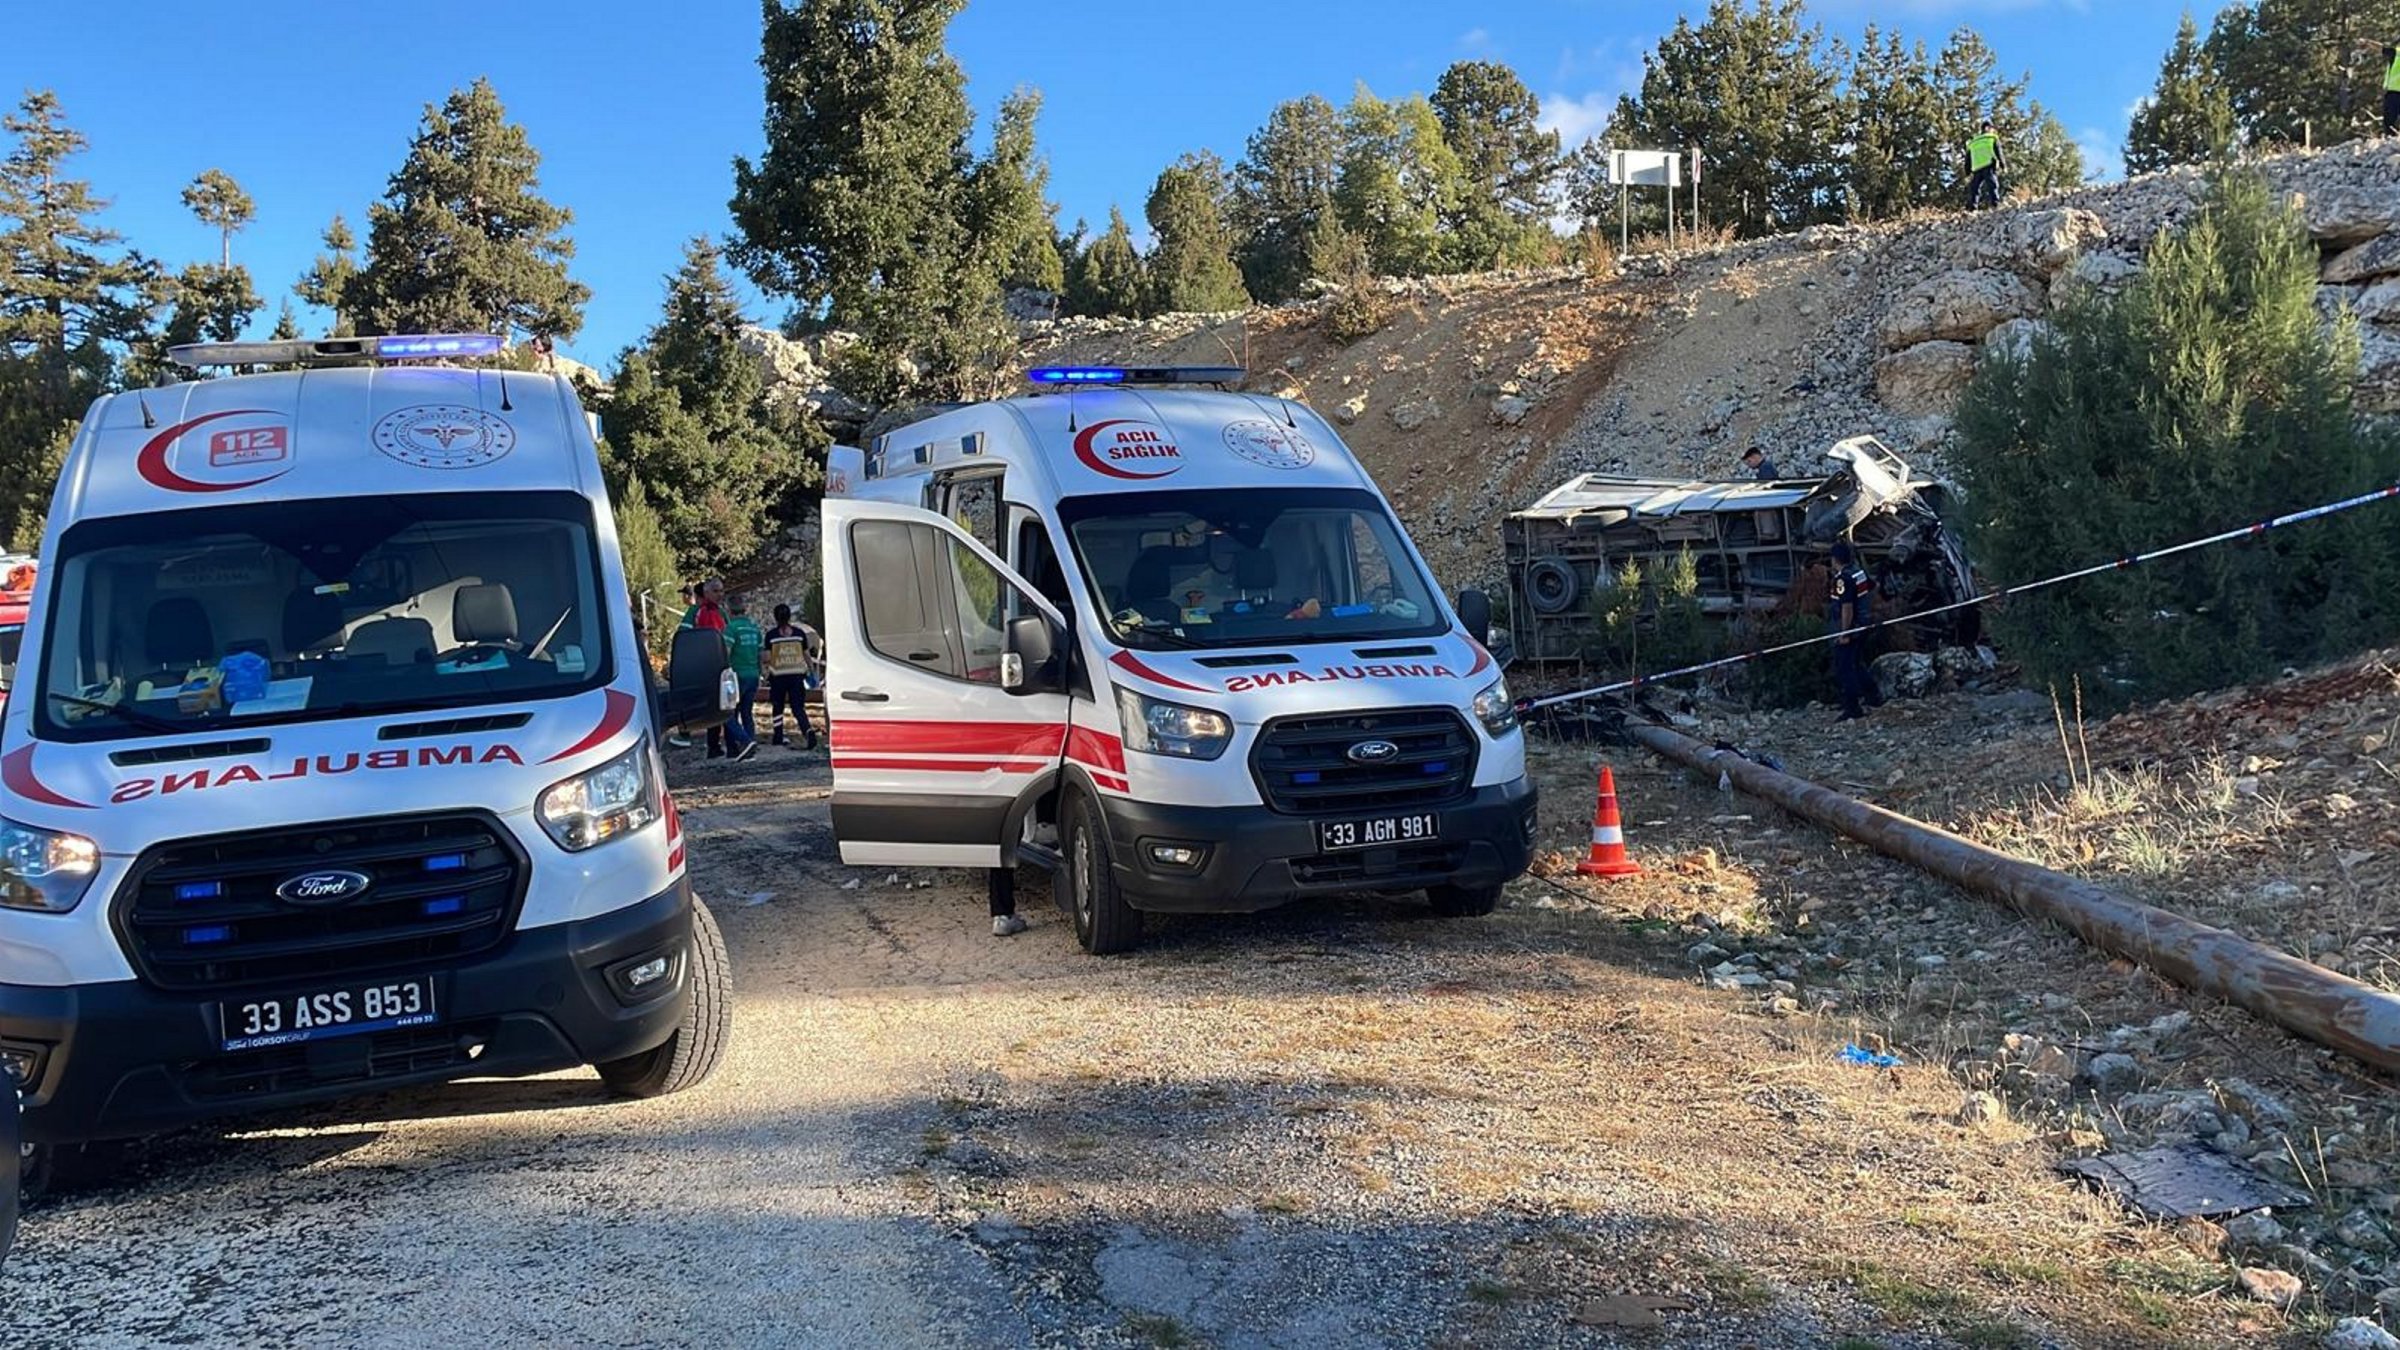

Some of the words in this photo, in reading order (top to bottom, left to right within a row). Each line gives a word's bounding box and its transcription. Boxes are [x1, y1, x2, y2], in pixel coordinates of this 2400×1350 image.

[222, 431, 274, 451] 112
[1108, 444, 1181, 459] SAĞLIK
[1333, 824, 1355, 844] 33
[1365, 819, 1396, 842] AGM
[1402, 815, 1432, 838] 981
[297, 876, 347, 897] Ford
[242, 1001, 281, 1035] 33
[295, 991, 352, 1029] ASS
[364, 982, 421, 1018] 853
